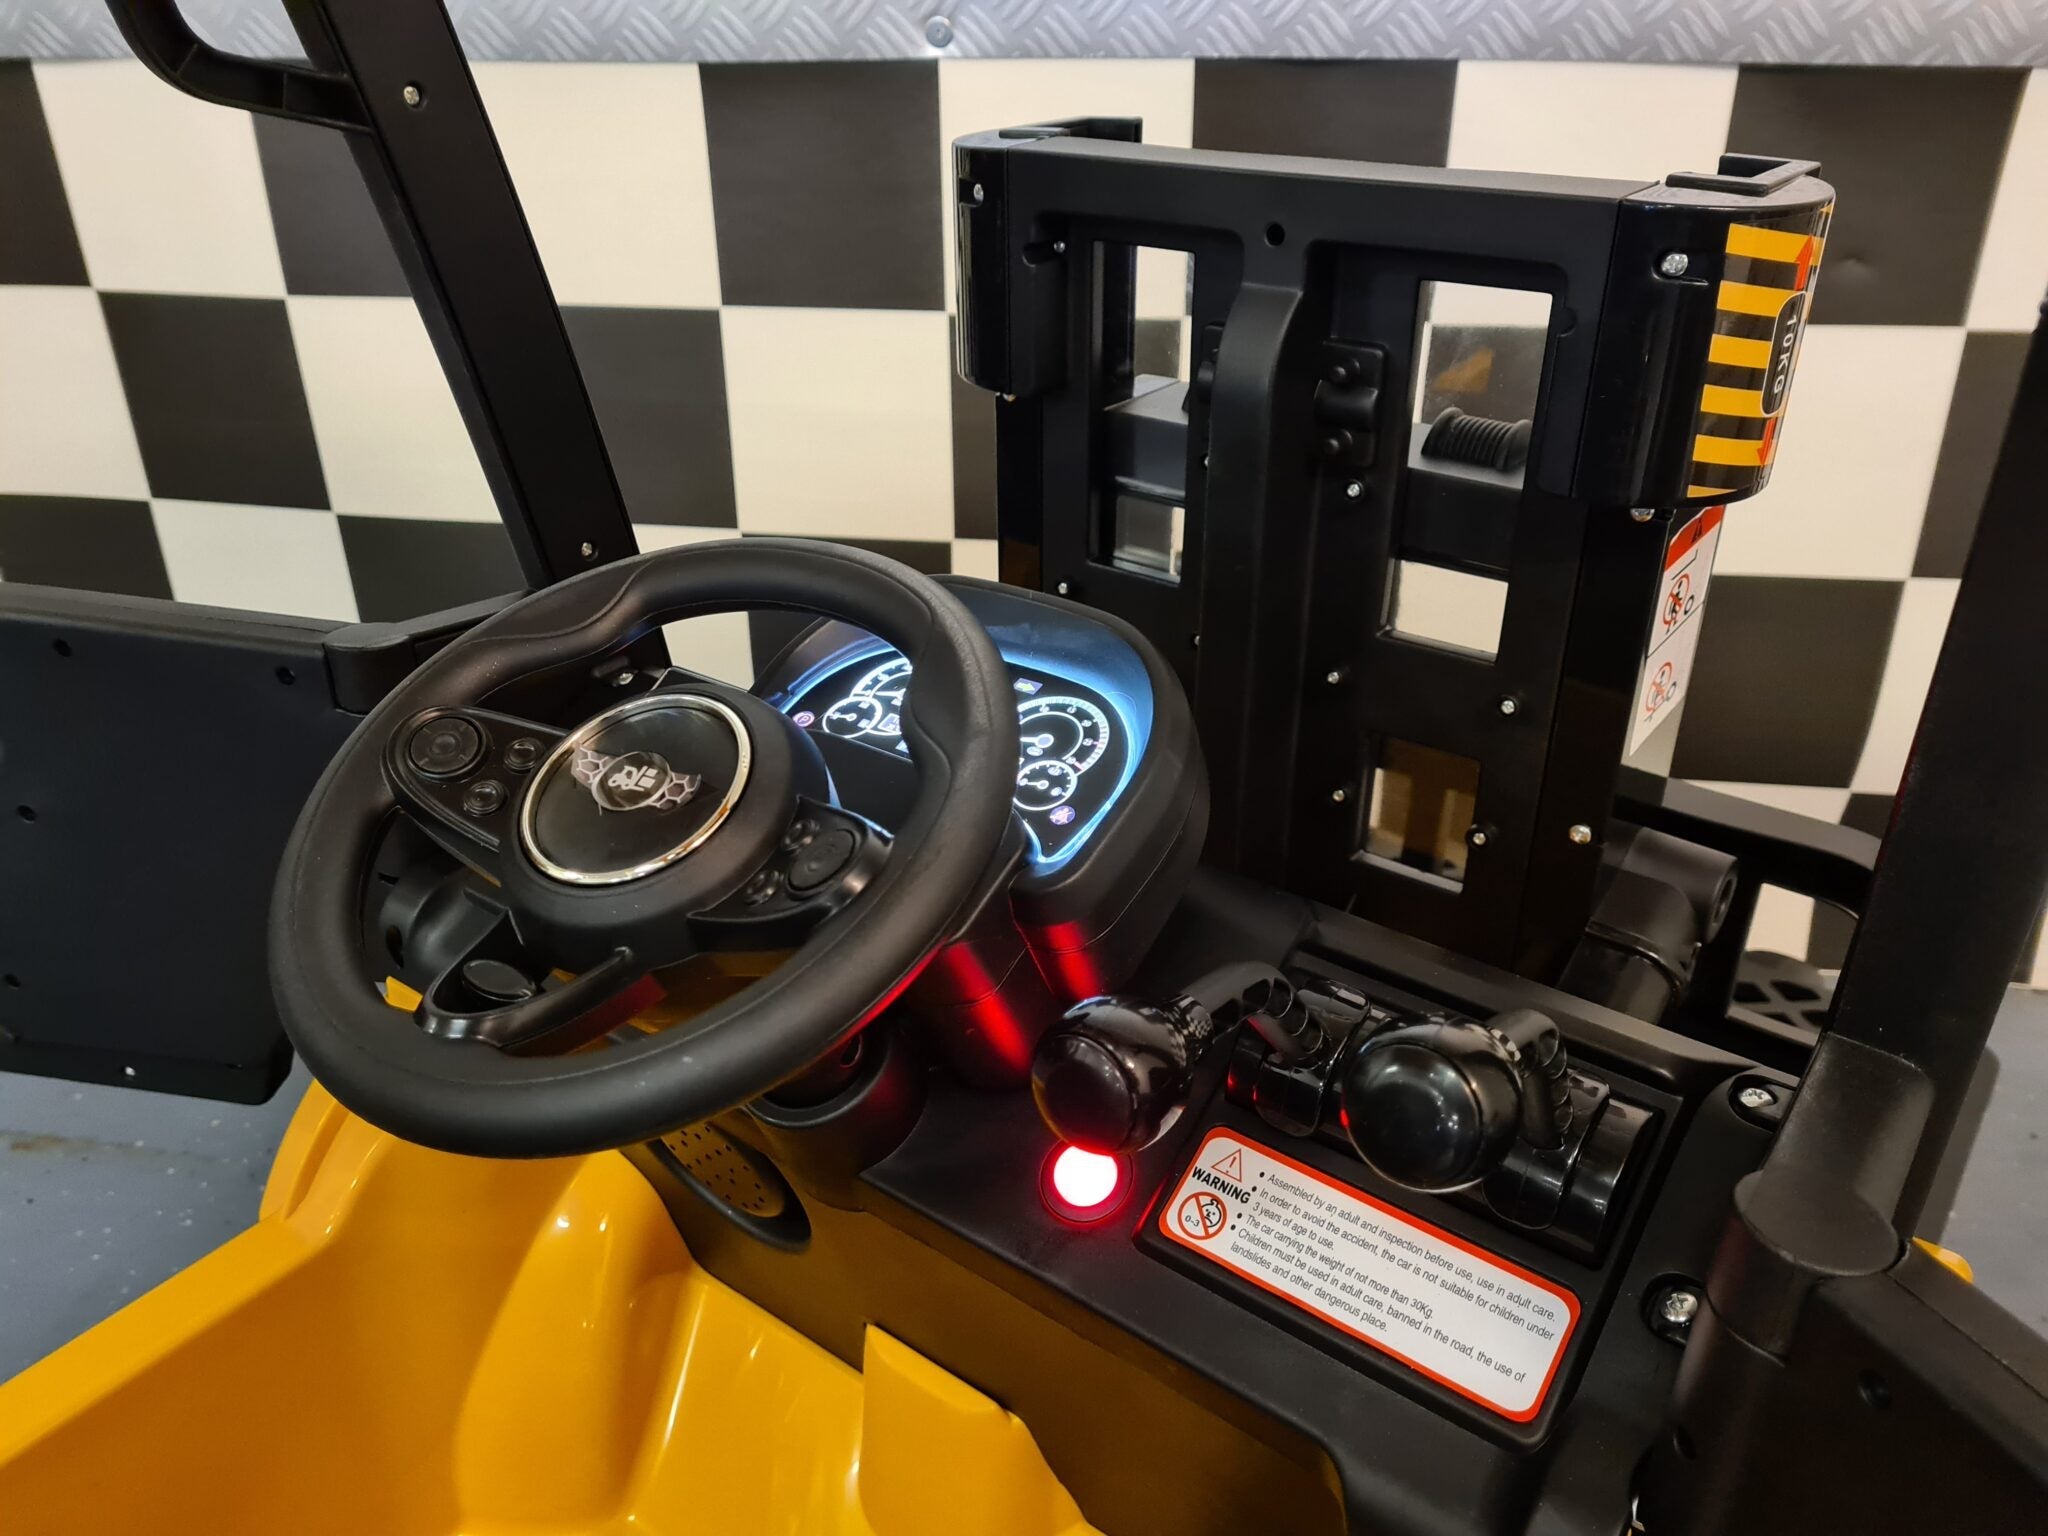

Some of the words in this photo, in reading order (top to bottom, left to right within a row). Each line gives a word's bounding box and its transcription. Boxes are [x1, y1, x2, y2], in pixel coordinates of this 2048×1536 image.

[1774, 315, 1797, 394] 10KG
[1191, 1166, 1251, 1204] WARNING
[1252, 1201, 1260, 1211] 3
[1257, 1206, 1281, 1223] years
[1281, 1218, 1293, 1227] of
[1290, 1222, 1307, 1235] age
[1307, 1229, 1317, 1240] to
[1317, 1235, 1333, 1250] use.
[1230, 1240, 1271, 1269] landslides
[1271, 1264, 1291, 1279] and
[1289, 1274, 1313, 1290] other
[1313, 1286, 1360, 1317] dangerous
[1359, 1311, 1386, 1332] place.
[1245, 1213, 1260, 1229] The
[1260, 1224, 1275, 1235] car
[1273, 1231, 1304, 1254] carrying
[1304, 1244, 1318, 1258] the
[1318, 1253, 1345, 1272] weight
[1344, 1266, 1355, 1277] of
[1353, 1271, 1368, 1284] not
[1367, 1278, 1389, 1295] more
[1389, 1288, 1409, 1305] than
[1409, 1298, 1432, 1319] 30Kg.
[1259, 1187, 1268, 1199] In
[1268, 1194, 1292, 1210] order
[1291, 1203, 1301, 1215] to
[1301, 1210, 1326, 1227] avoid
[1325, 1220, 1340, 1234] the
[1340, 1230, 1378, 1256] accident,
[1380, 1248, 1395, 1262] the
[1396, 1257, 1413, 1270] car
[1412, 1263, 1421, 1275] is
[1421, 1270, 1438, 1284] not
[1439, 1279, 1474, 1301] suitable
[1474, 1294, 1489, 1308] for
[1488, 1303, 1525, 1327] children
[1525, 1321, 1554, 1340] under
[1266, 1173, 1314, 1202] Assembled
[1312, 1195, 1325, 1209] by
[1324, 1203, 1337, 1214] an
[1337, 1209, 1360, 1225] adult
[1359, 1220, 1379, 1234] and
[1377, 1226, 1423, 1256] inspection
[1423, 1248, 1453, 1271] before
[1454, 1266, 1473, 1283] use,
[1476, 1276, 1494, 1291] use
[1495, 1283, 1505, 1296] in
[1505, 1291, 1531, 1308] adult
[1531, 1304, 1554, 1322] care.
[1238, 1227, 1272, 1252] Children
[1272, 1247, 1295, 1264] must
[1294, 1256, 1306, 1270] be
[1307, 1265, 1331, 1282] used
[1329, 1274, 1339, 1287] in
[1339, 1282, 1363, 1299] adult
[1362, 1294, 1383, 1313] care,
[1386, 1304, 1423, 1330] banned
[1422, 1322, 1432, 1335] in
[1433, 1328, 1449, 1344] the
[1449, 1338, 1474, 1359] road,
[1476, 1350, 1492, 1366] the
[1493, 1361, 1512, 1376] use
[1513, 1371, 1526, 1383] of
